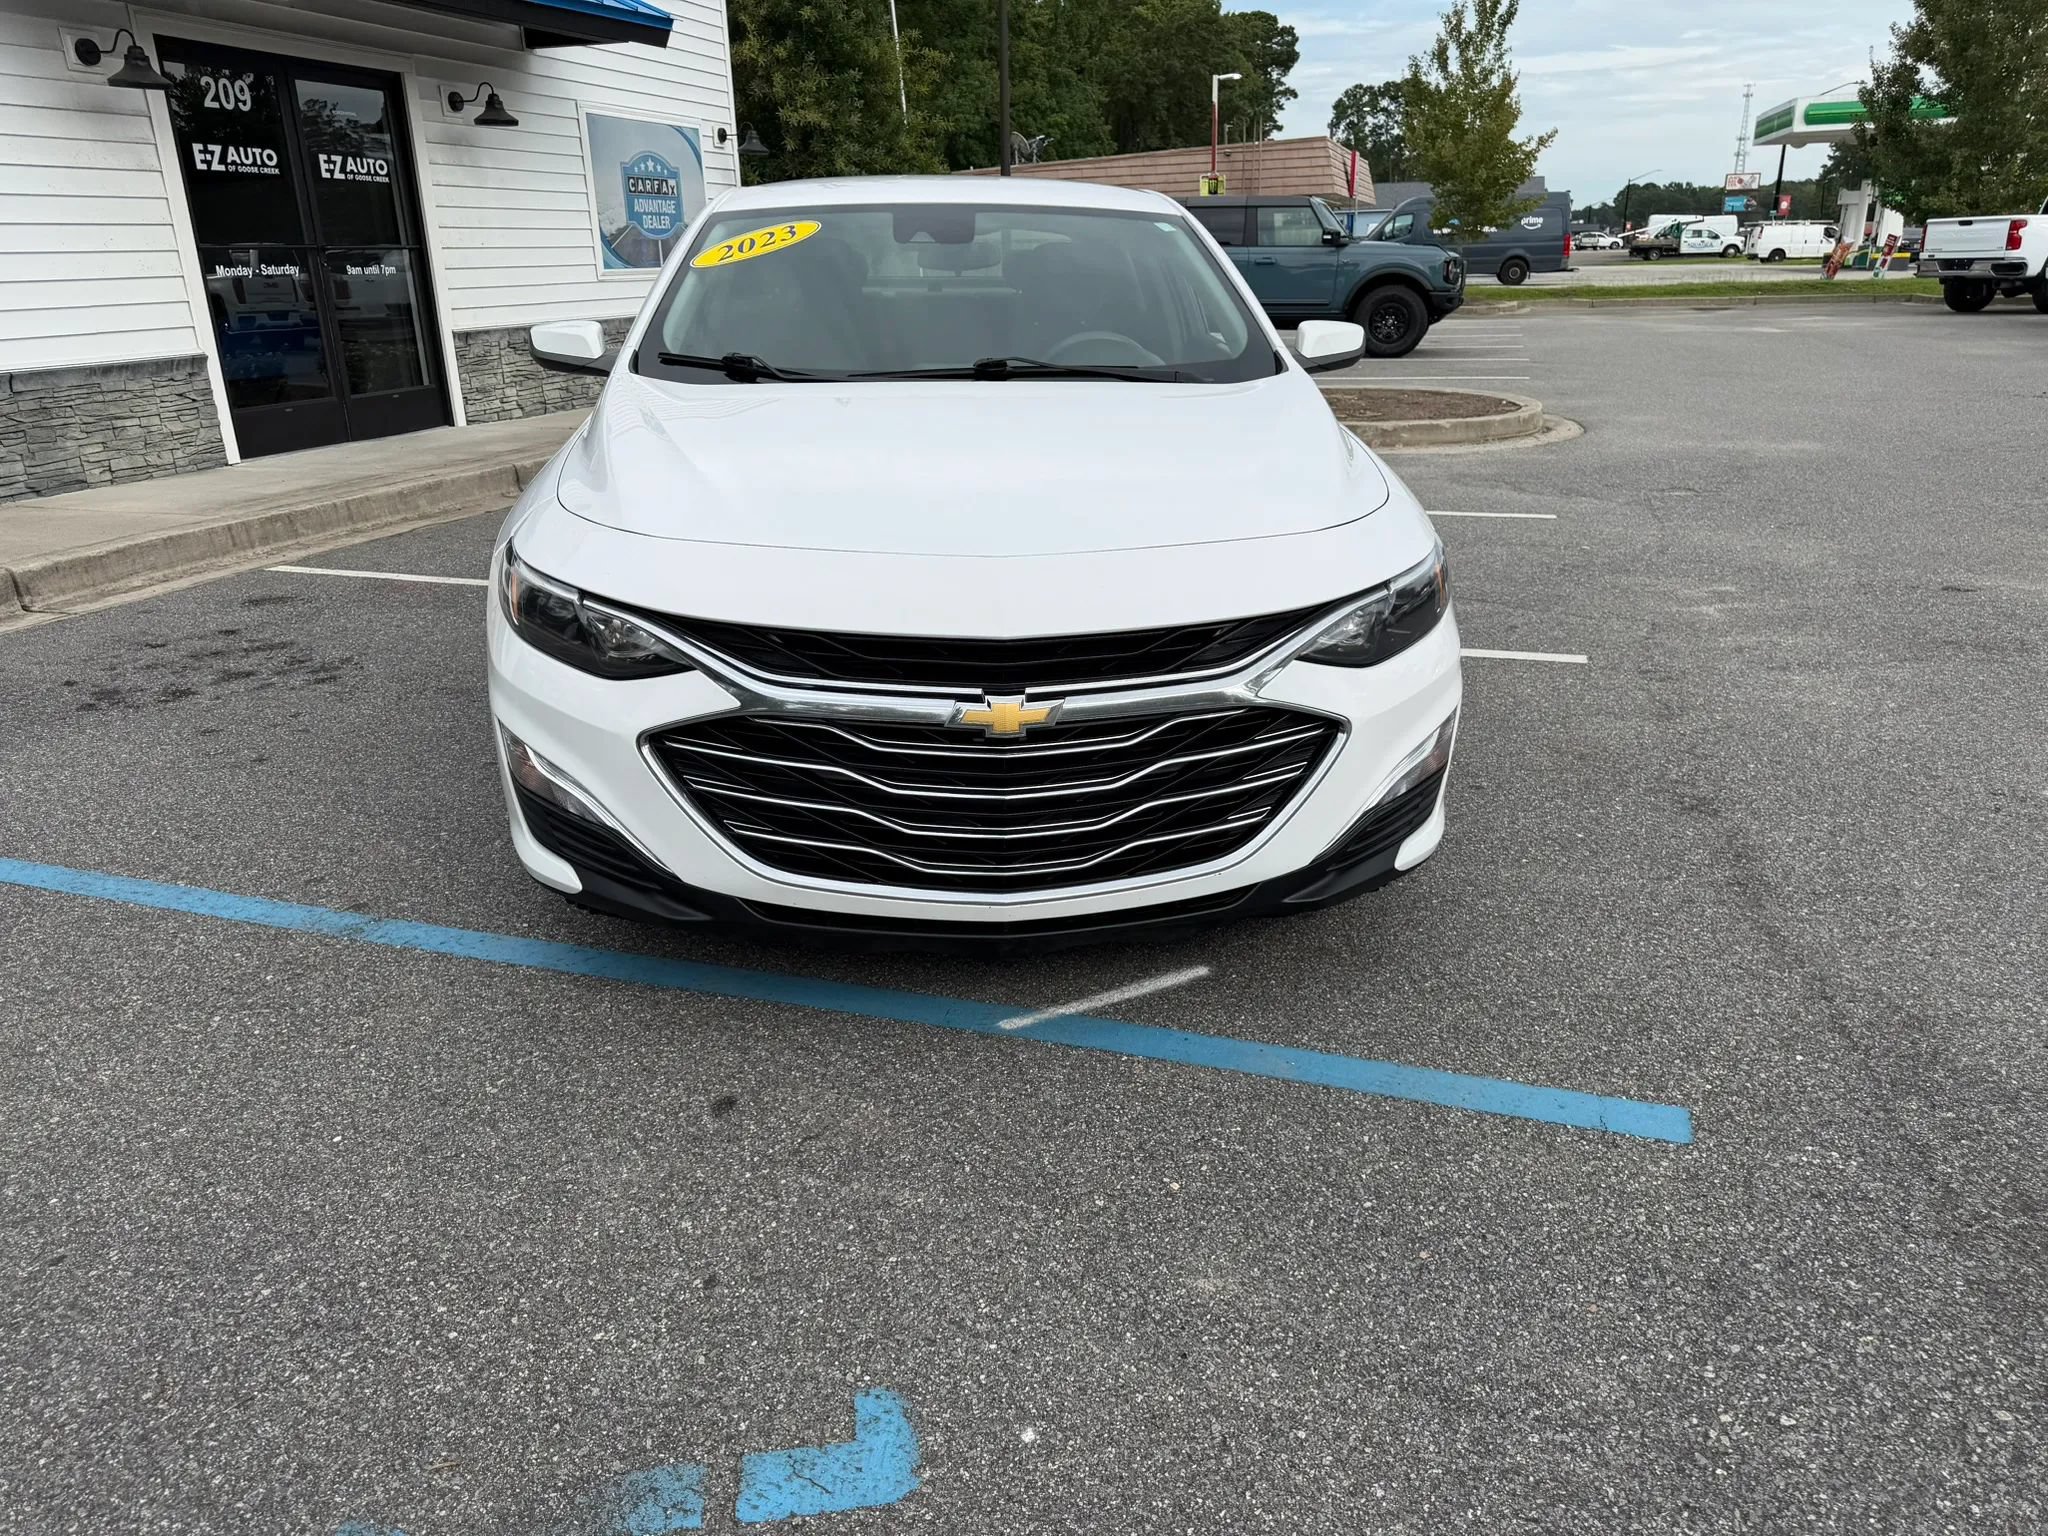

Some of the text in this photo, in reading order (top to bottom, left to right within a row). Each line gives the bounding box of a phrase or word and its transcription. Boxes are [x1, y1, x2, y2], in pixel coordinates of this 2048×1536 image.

[200, 75, 252, 112] 209
[227, 146, 278, 167] AUTO
[237, 166, 260, 174] GOOSE
[260, 167, 281, 175] CREEK
[346, 156, 389, 176] AUTO
[627, 175, 678, 197] CARFAX
[633, 198, 677, 215] ADVANTAGE
[642, 214, 671, 230] DEALER
[1520, 216, 1544, 225] prime
[717, 224, 797, 263] 2023
[215, 264, 253, 279] Monday
[260, 263, 300, 277] Saturday
[346, 264, 397, 277] 9am until 7pm
